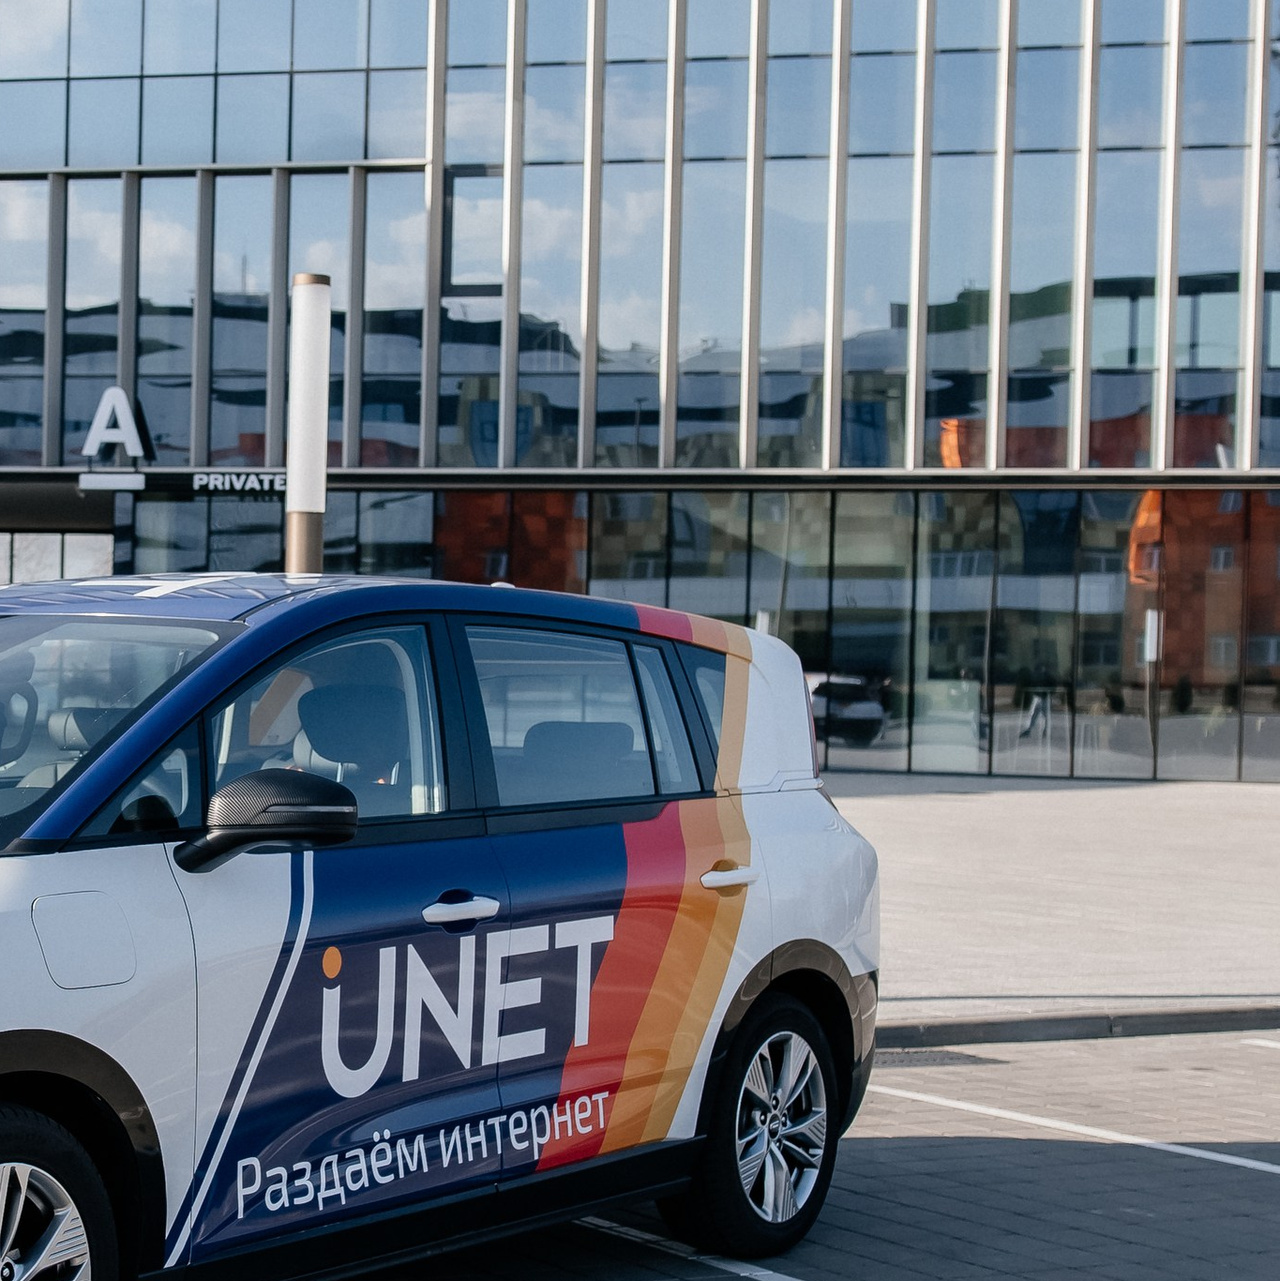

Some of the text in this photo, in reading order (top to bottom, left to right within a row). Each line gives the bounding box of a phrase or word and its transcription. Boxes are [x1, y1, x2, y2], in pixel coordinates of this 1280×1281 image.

[81, 386, 145, 457] A
[192, 473, 286, 491] PRIVATE
[236, 1091, 610, 1220] Раздаём интернет
